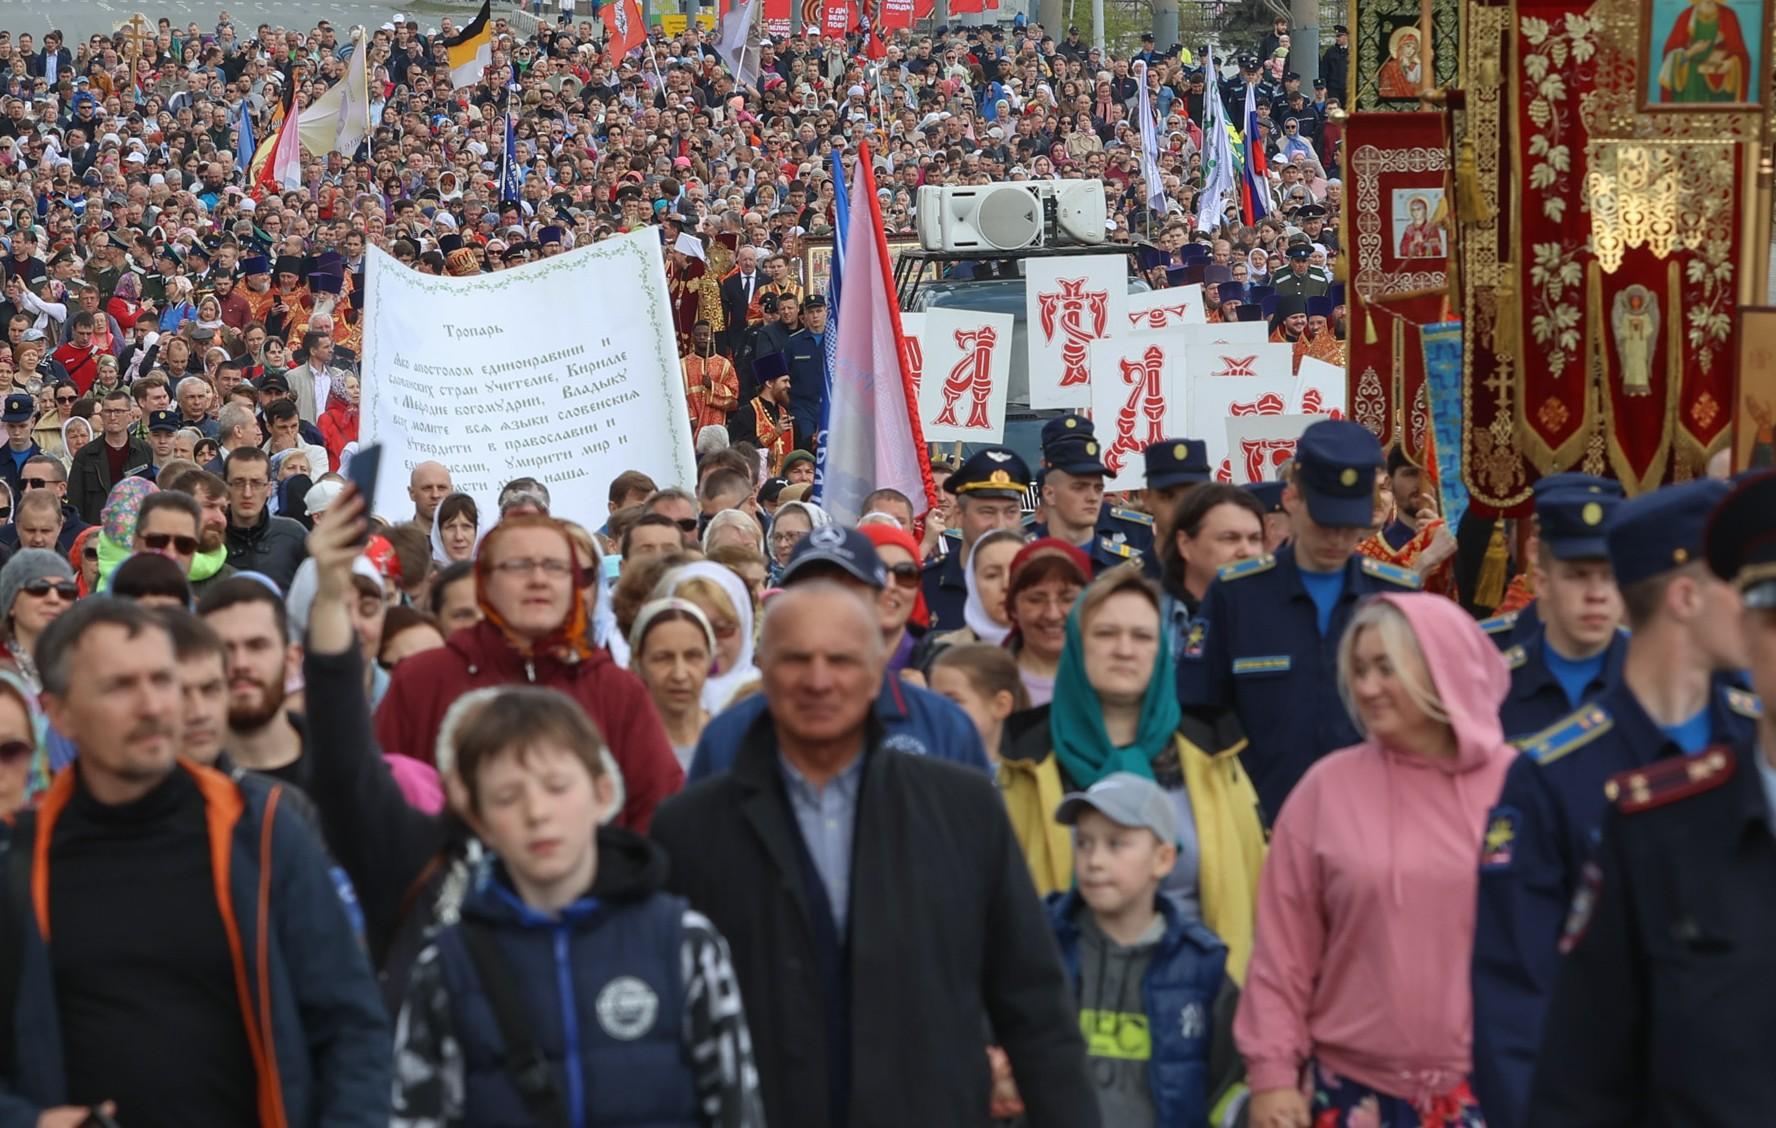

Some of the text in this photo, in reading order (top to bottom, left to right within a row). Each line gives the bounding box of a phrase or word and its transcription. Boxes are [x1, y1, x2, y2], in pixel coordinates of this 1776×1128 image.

[443, 324, 504, 341] Тропарь
[601, 337, 611, 347] и
[440, 385, 478, 399] стран
[566, 352, 627, 377] Кирилле
[606, 417, 616, 428] и
[581, 440, 610, 456] мир
[618, 435, 628, 445] и
[455, 481, 488, 493] асти
